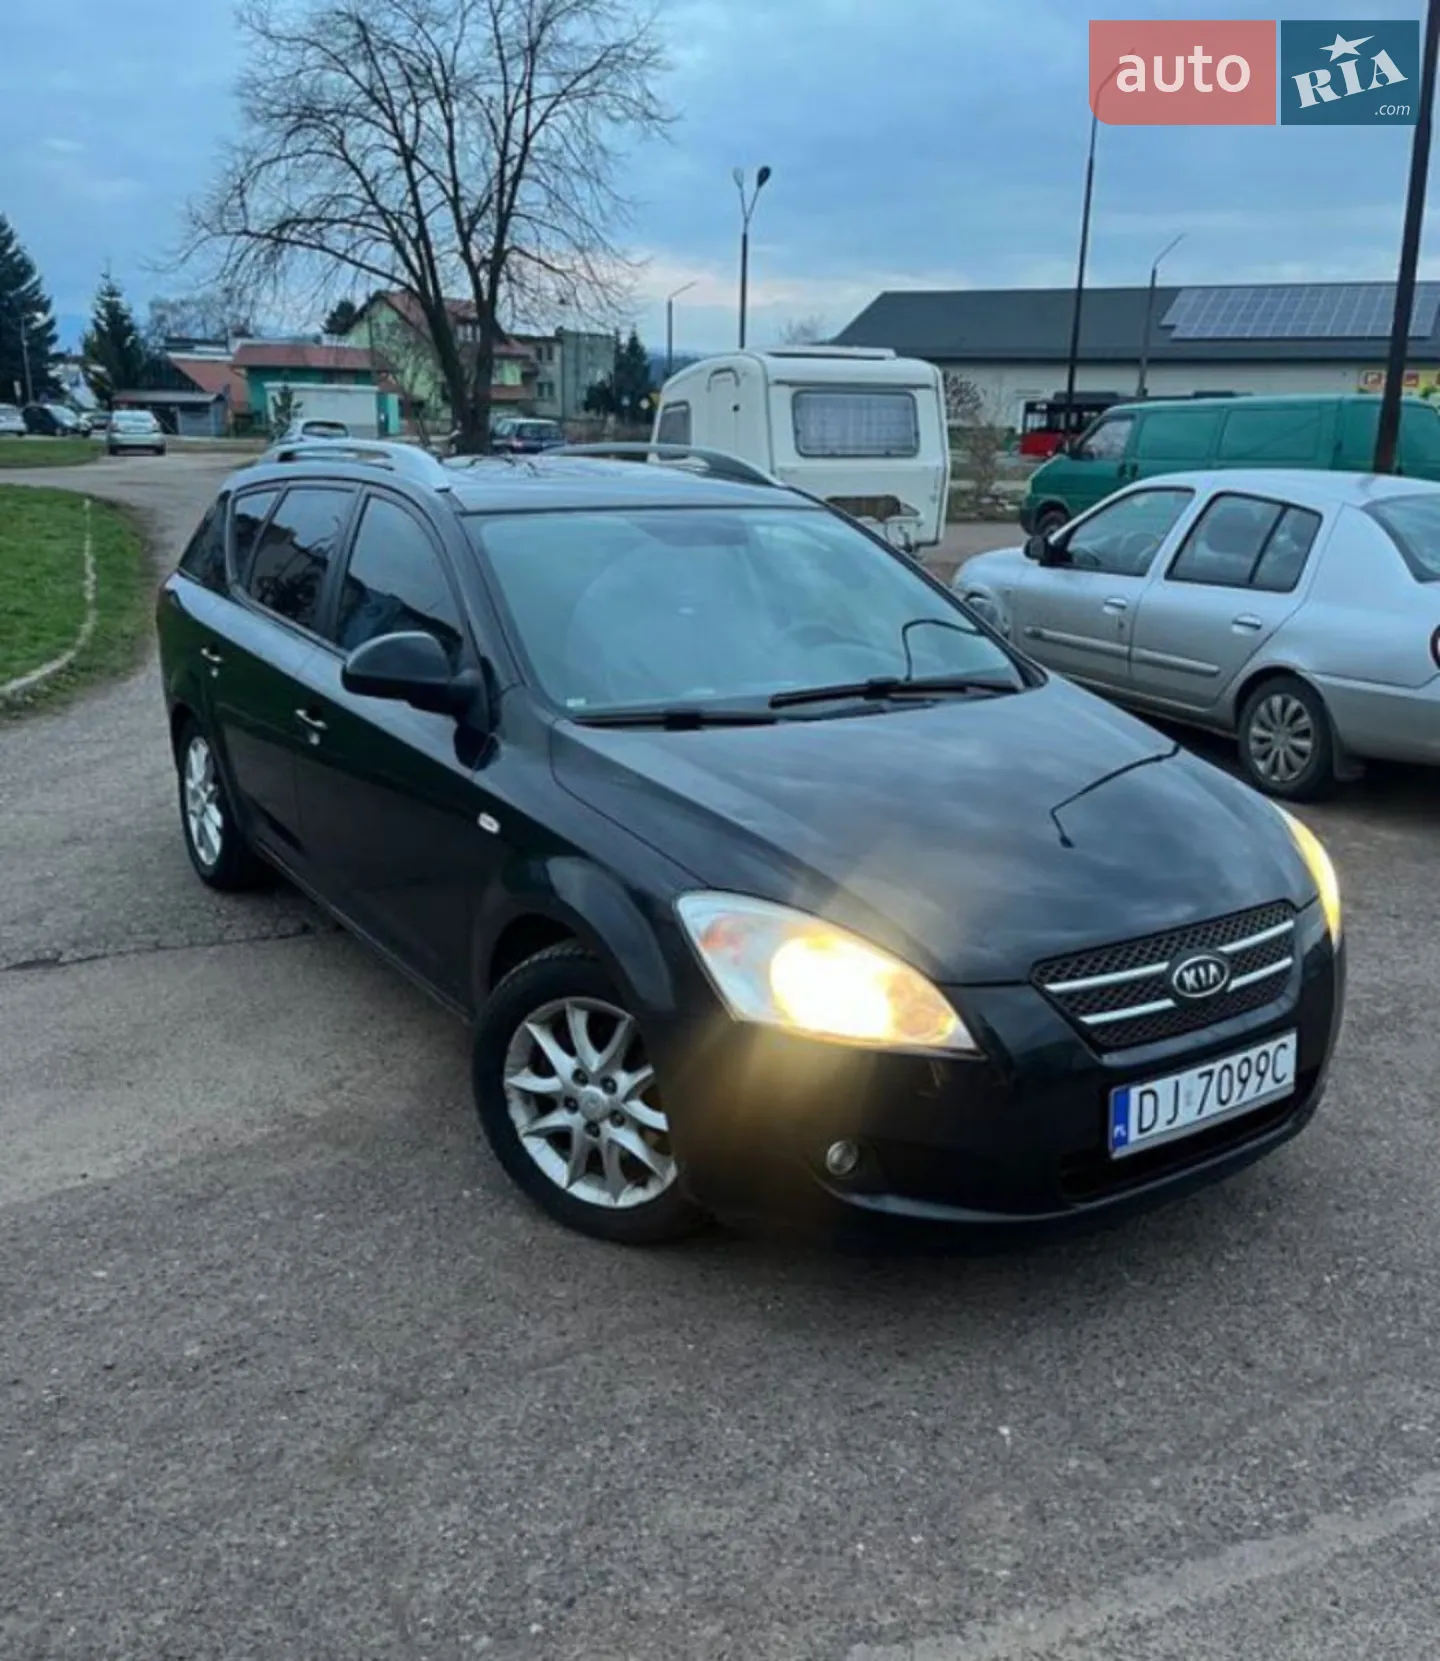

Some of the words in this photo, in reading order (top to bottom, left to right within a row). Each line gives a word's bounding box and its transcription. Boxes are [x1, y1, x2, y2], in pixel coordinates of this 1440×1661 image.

[1182, 963, 1221, 991] KIA
[1137, 1080, 1180, 1134] DJ
[1197, 1043, 1288, 1116] 7099C
